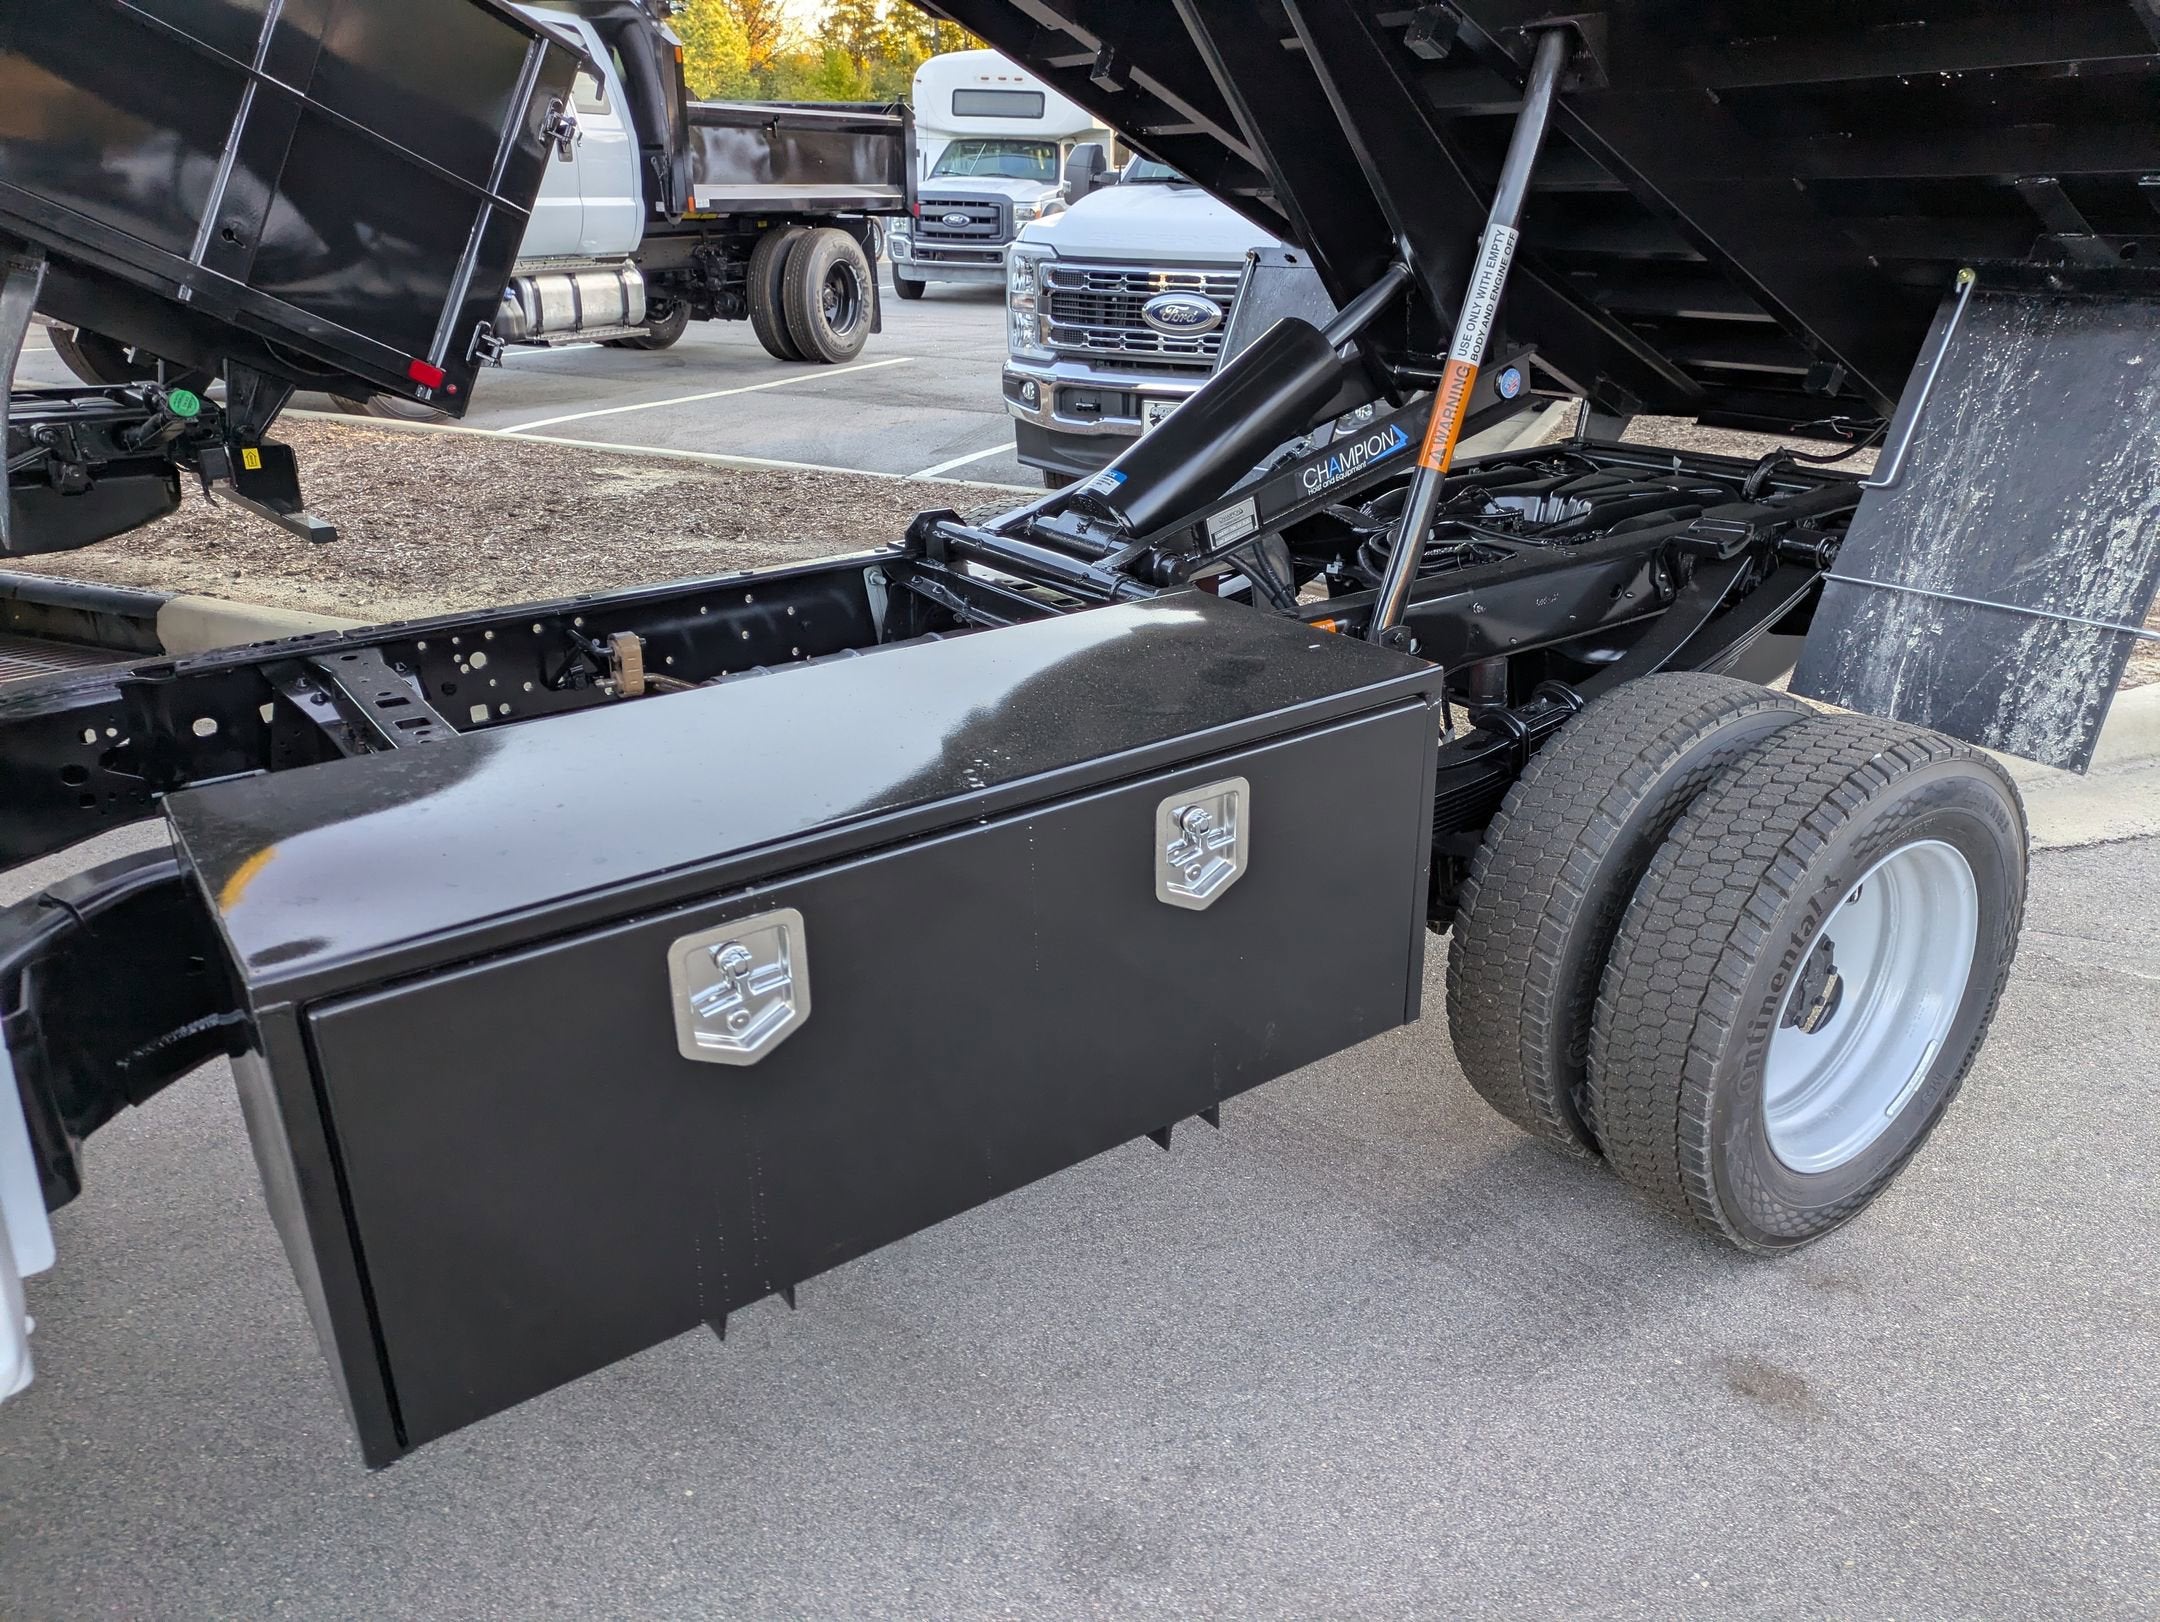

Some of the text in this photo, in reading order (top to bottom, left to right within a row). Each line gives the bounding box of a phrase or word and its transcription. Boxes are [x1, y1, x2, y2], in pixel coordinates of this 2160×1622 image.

[1160, 304, 1199, 324] Ford
[1458, 229, 1506, 357] USE ONLY WITH EMPTY
[1470, 231, 1516, 362] BODY AND ENGINE OFF
[1432, 365, 1471, 445] WARNING
[1302, 427, 1396, 489] CHAMPION
[1307, 460, 1367, 497] Hoist and Equipment
[1736, 896, 1824, 1100] Continental
